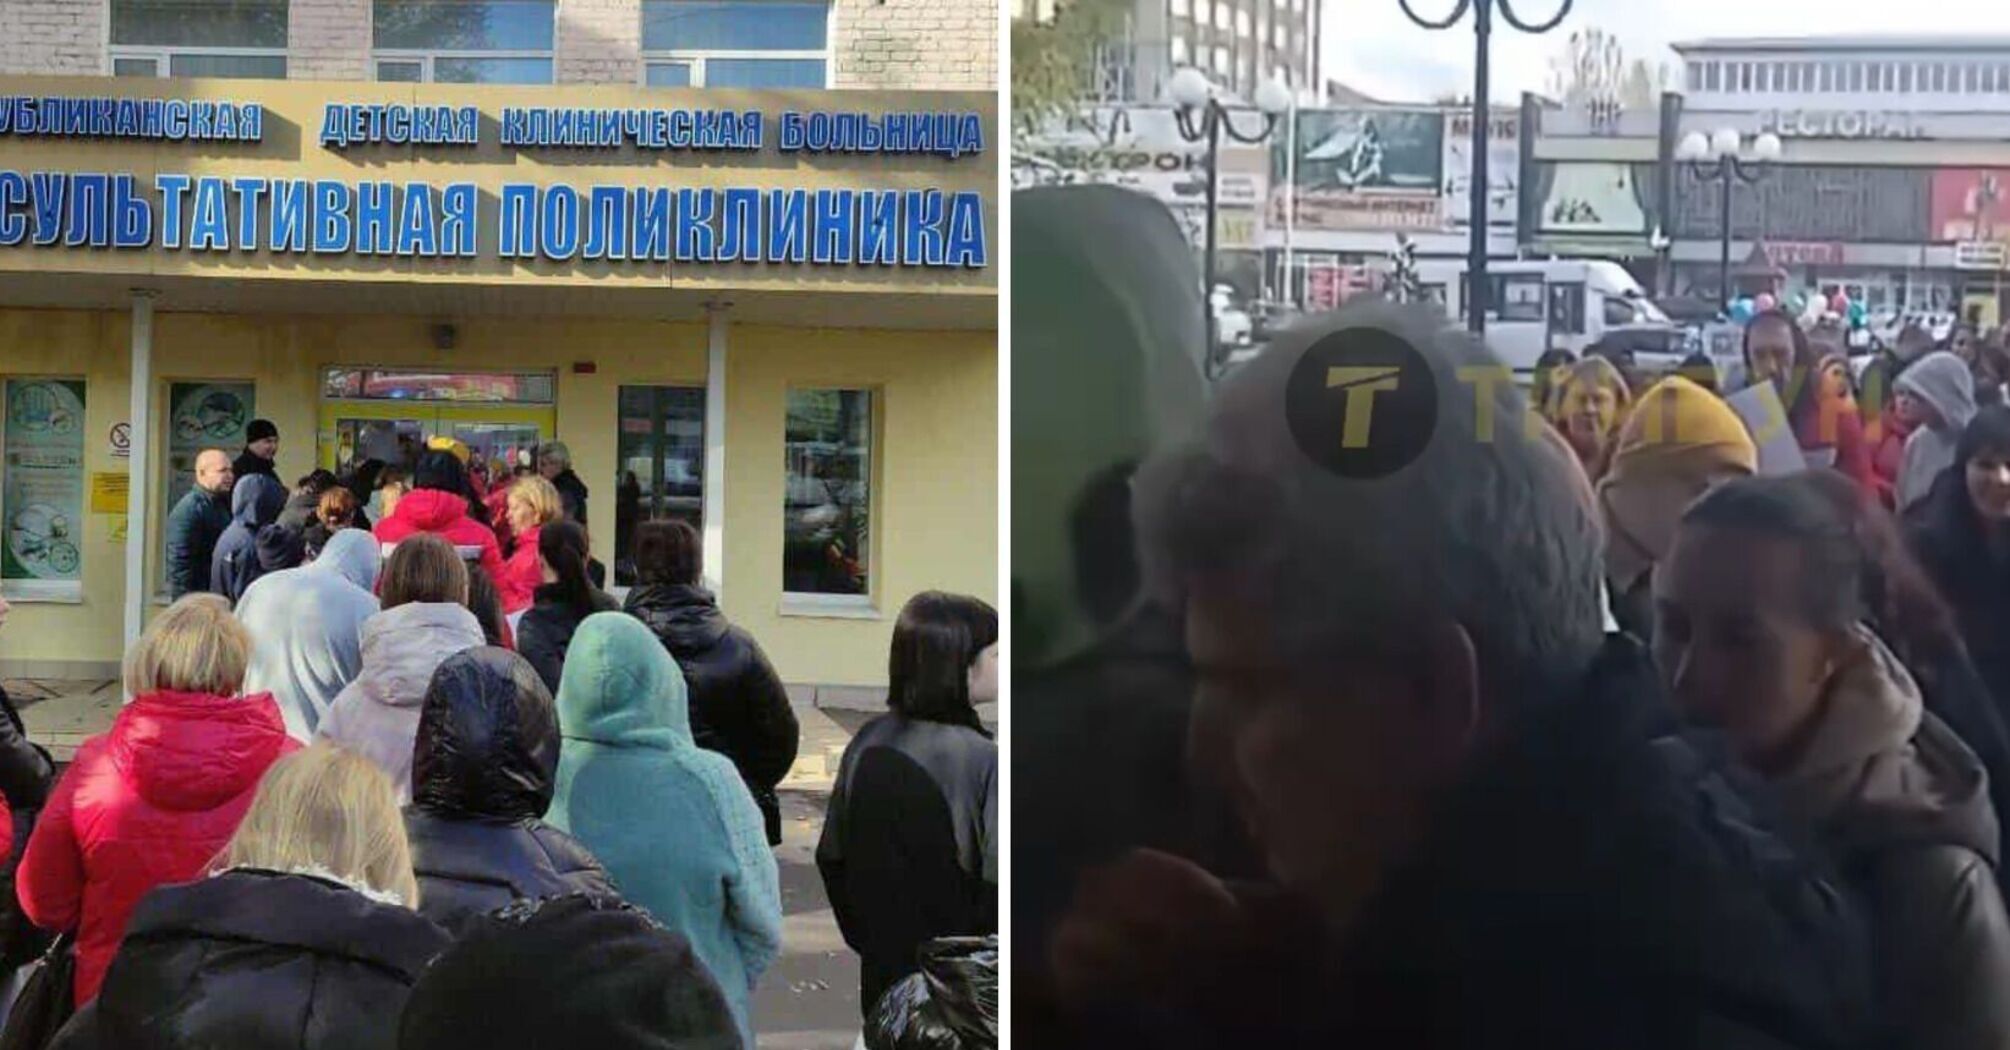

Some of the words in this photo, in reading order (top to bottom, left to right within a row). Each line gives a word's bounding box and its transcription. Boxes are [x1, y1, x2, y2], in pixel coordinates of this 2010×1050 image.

[319, 104, 479, 147] ДЕТСКАЯ
[500, 107, 763, 149] КЛИНИЧЕСКАЯ
[780, 112, 987, 158] БОЛЬНИЦА
[0, 169, 478, 257] СУЛЬТАТИВНАЯ
[499, 184, 988, 267] ПОЛИКЛИНИКА
